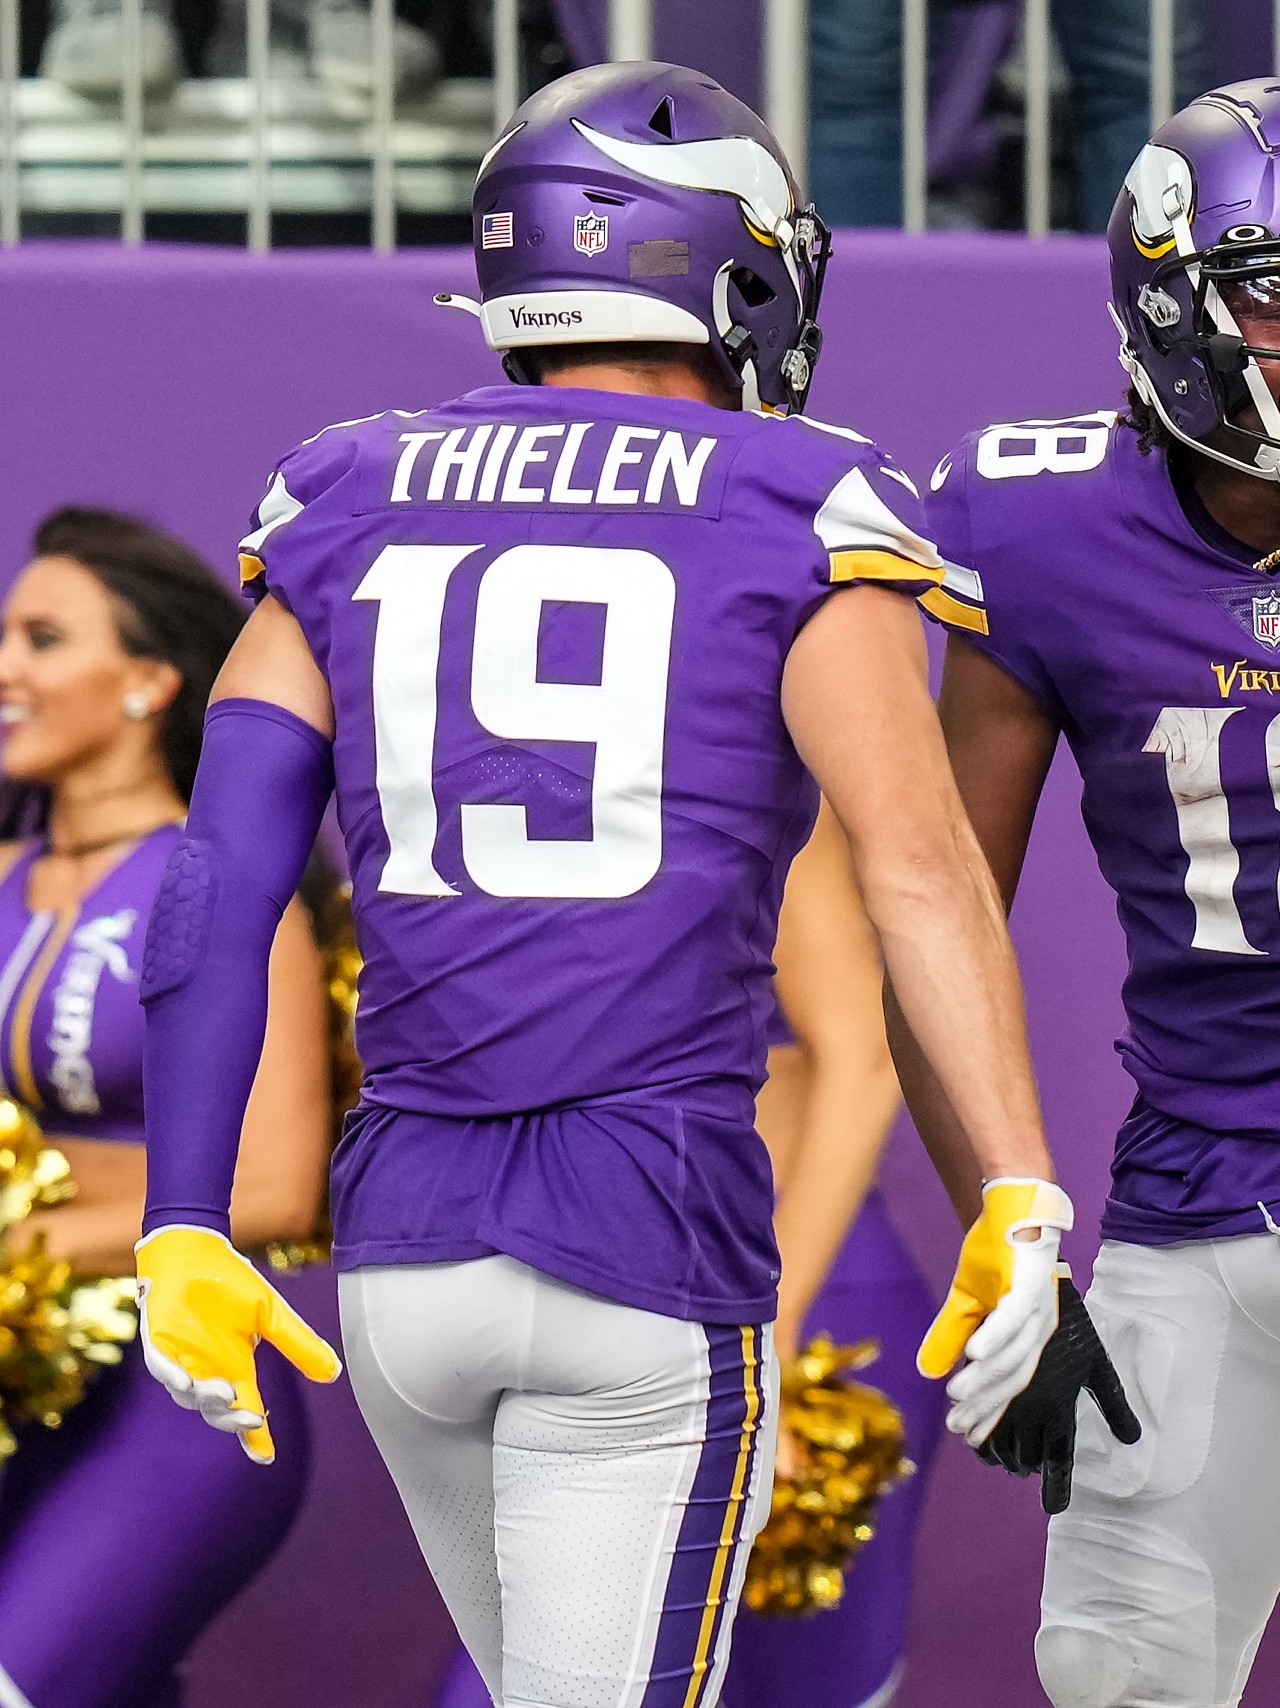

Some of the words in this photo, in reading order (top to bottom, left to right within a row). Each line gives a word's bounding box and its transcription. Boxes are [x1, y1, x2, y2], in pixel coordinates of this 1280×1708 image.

[579, 231, 603, 249] NFL
[390, 422, 718, 506] THIELEN
[352, 543, 676, 899] 19
